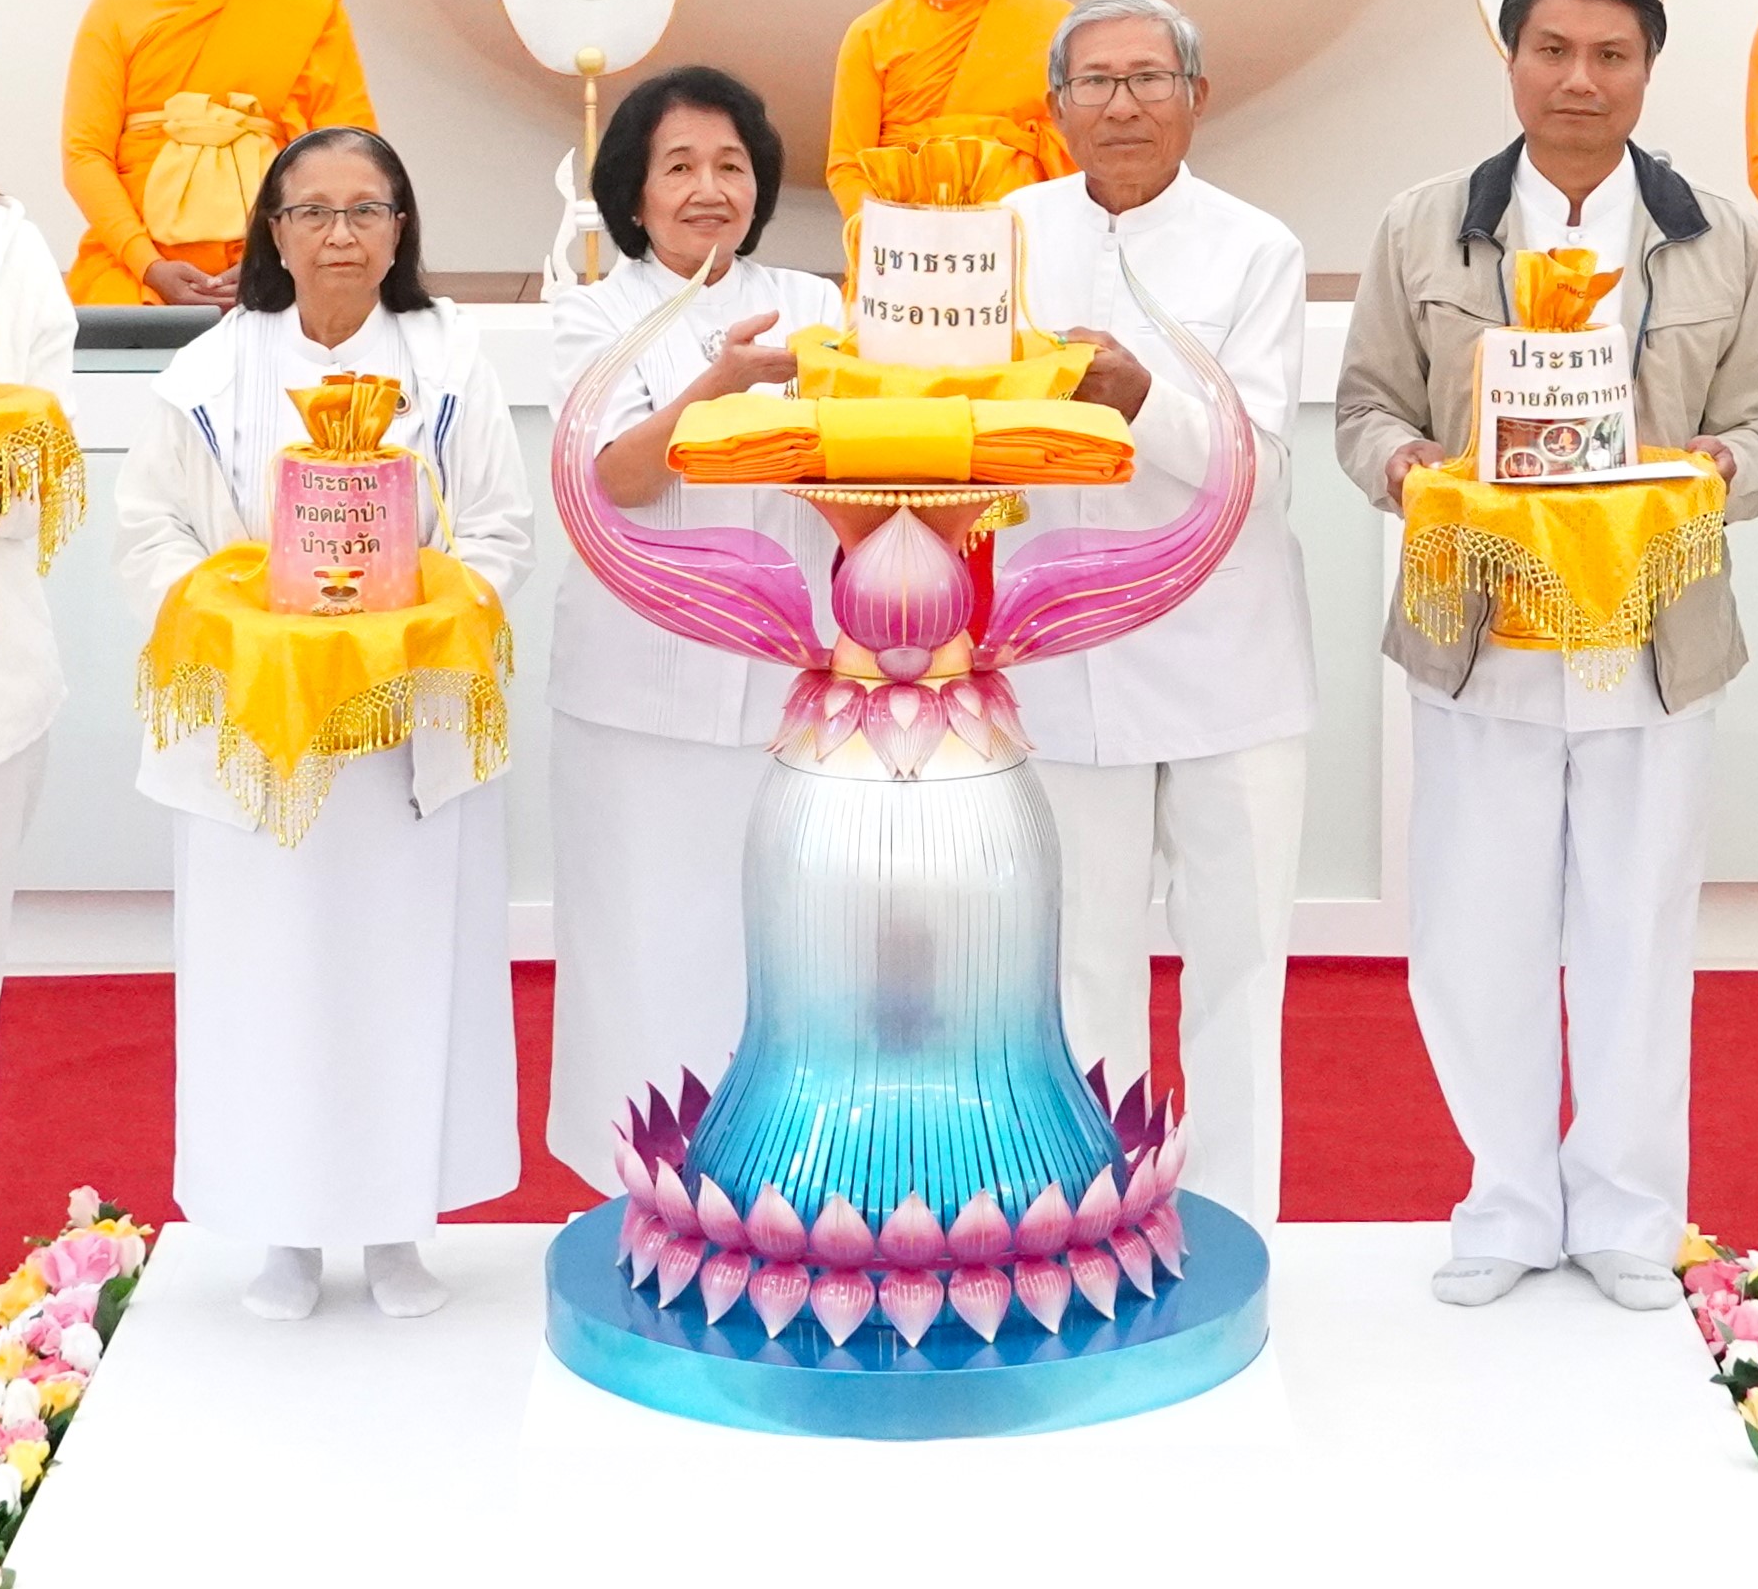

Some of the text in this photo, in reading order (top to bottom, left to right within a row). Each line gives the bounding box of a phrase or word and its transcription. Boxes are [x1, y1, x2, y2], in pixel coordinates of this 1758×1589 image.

[872, 245, 996, 276] บูชาธรรม
[861, 289, 1009, 328] พระอาจารย์
[1509, 338, 1614, 370] ประธาน
[1490, 383, 1629, 408] ถวายภัตตาหาร
[301, 471, 378, 492] ประธาน
[295, 501, 387, 524] ทอดผ้าป่า
[300, 531, 381, 564] บำรุงวัด
